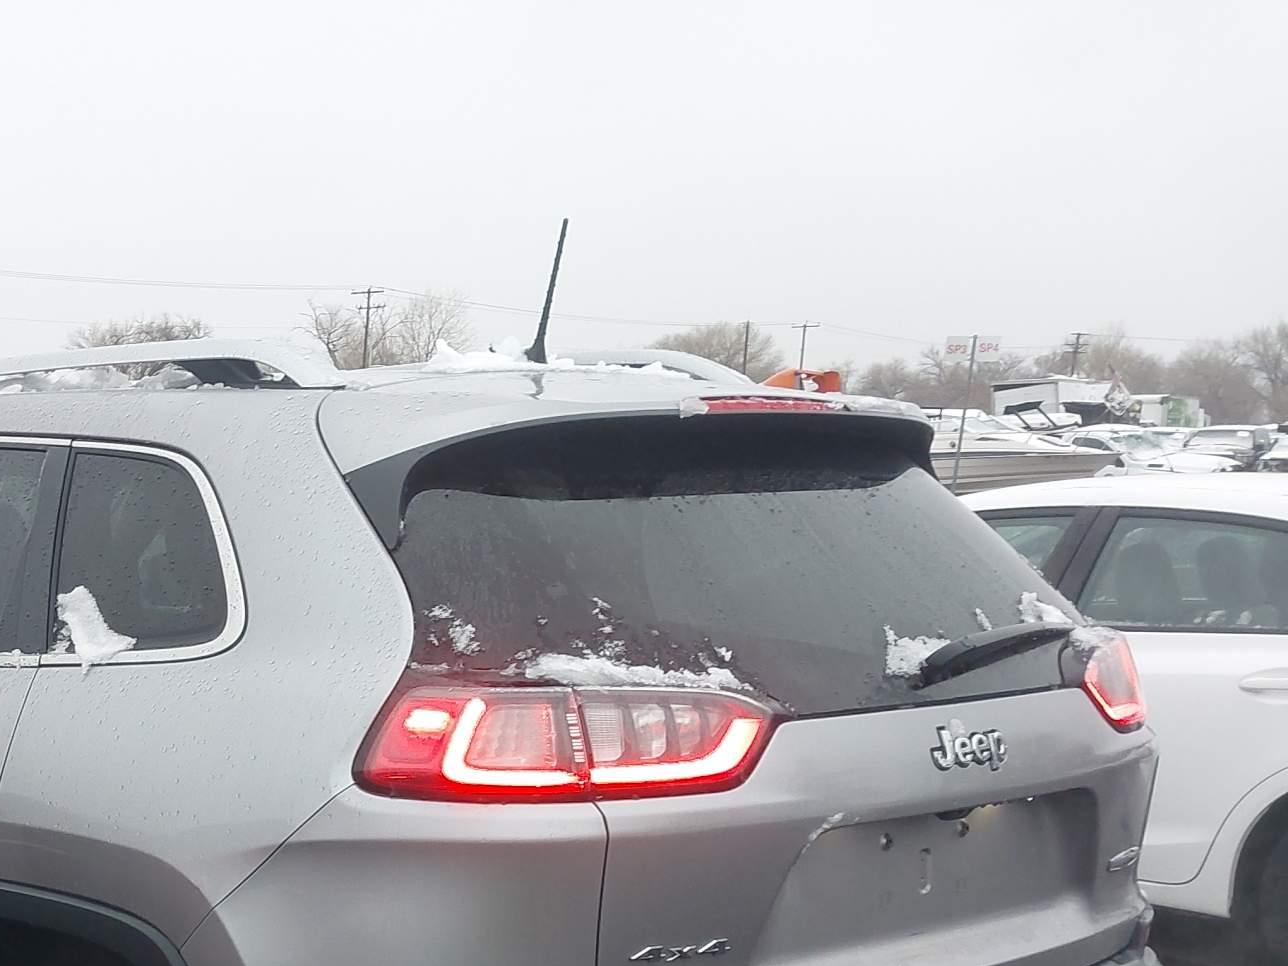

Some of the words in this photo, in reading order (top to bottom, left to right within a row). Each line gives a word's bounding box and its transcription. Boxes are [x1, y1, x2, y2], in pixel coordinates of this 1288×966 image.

[946, 344, 968, 353] SP3
[979, 343, 1000, 352] SP4
[930, 726, 1008, 771] Jeep
